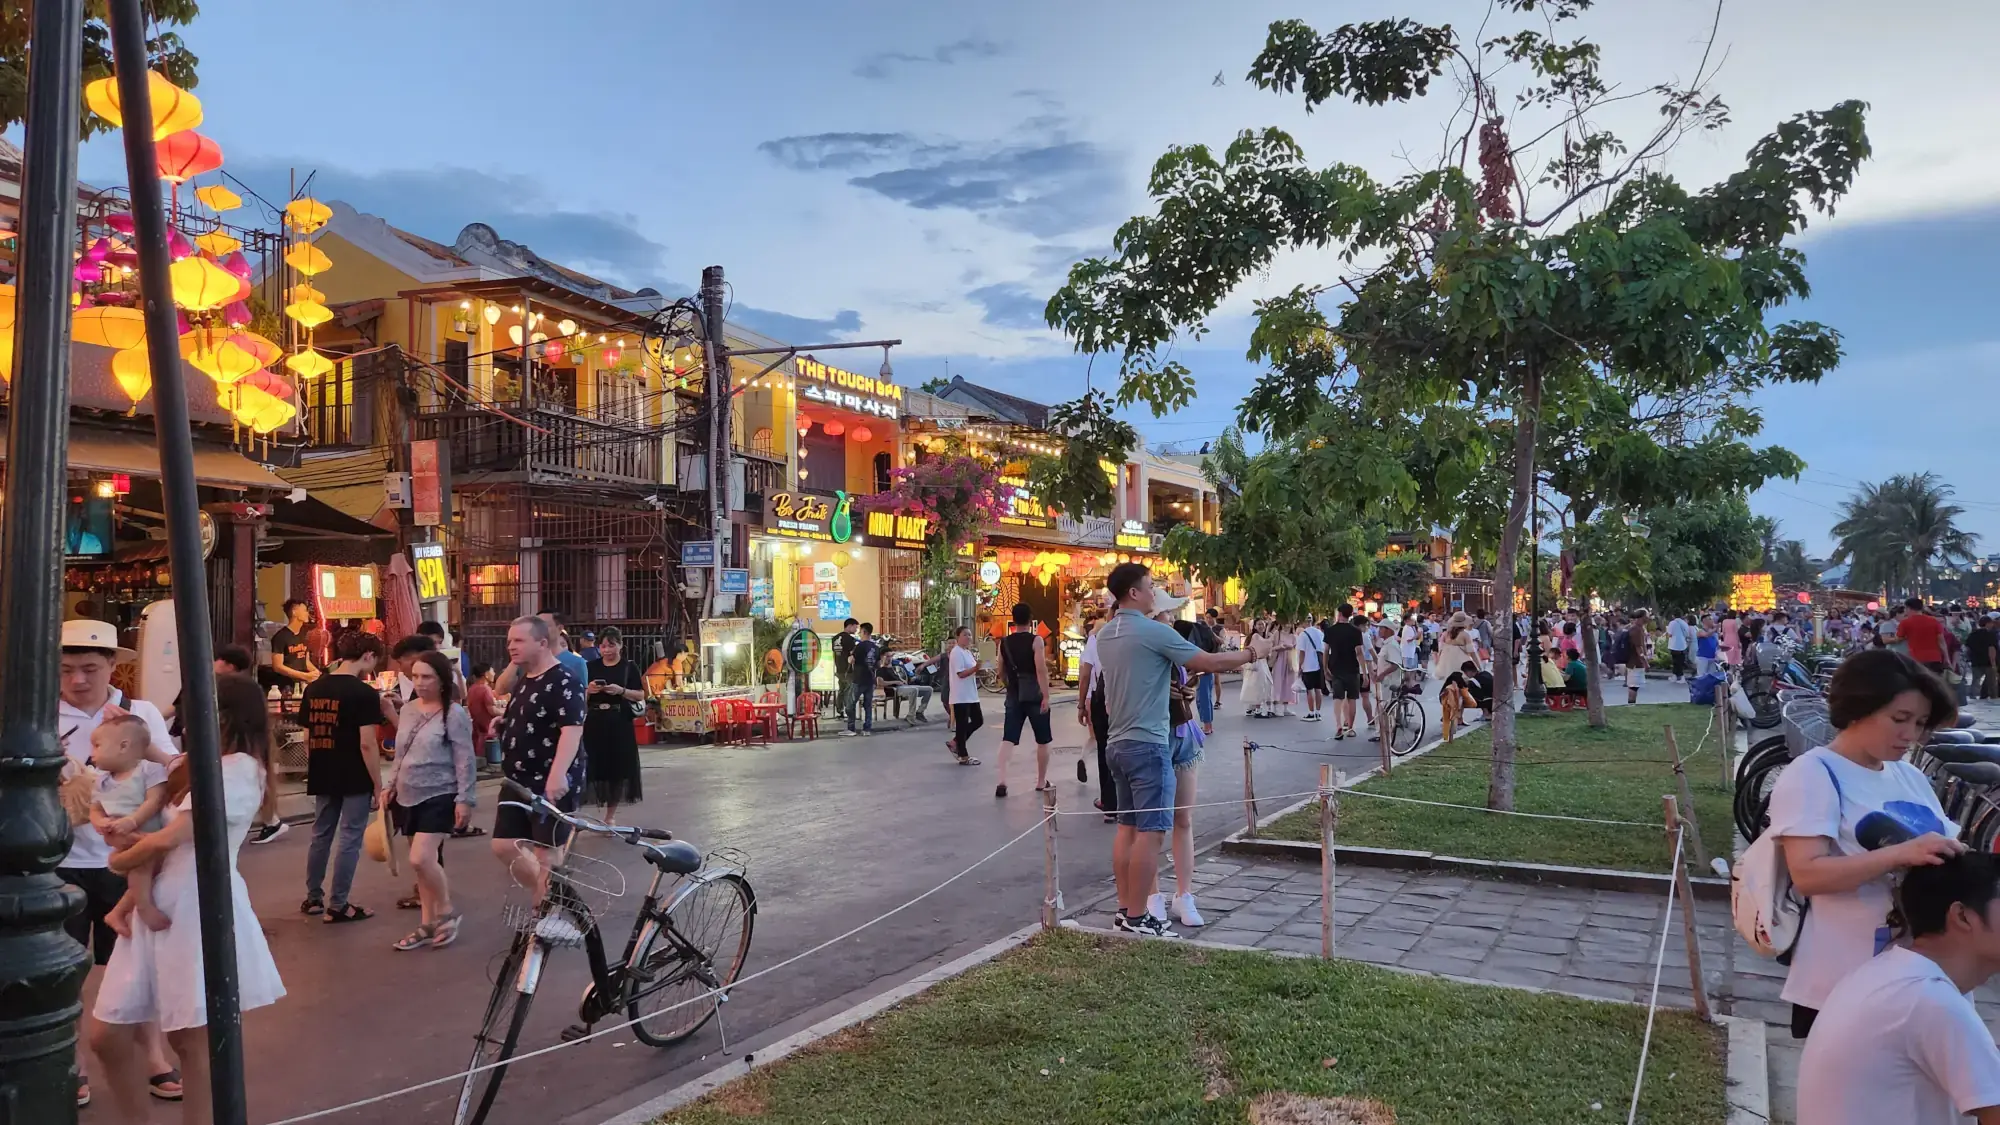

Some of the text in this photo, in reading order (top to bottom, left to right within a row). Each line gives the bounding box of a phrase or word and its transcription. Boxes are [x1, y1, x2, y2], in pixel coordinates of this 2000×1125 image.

[796, 357, 902, 401] THE TOUCH SPA
[868, 512, 928, 541] MINI MART
[417, 557, 447, 599] SPA
[983, 569, 998, 577] ATM
[797, 652, 812, 661] BAR
[687, 705, 700, 717] HOA
